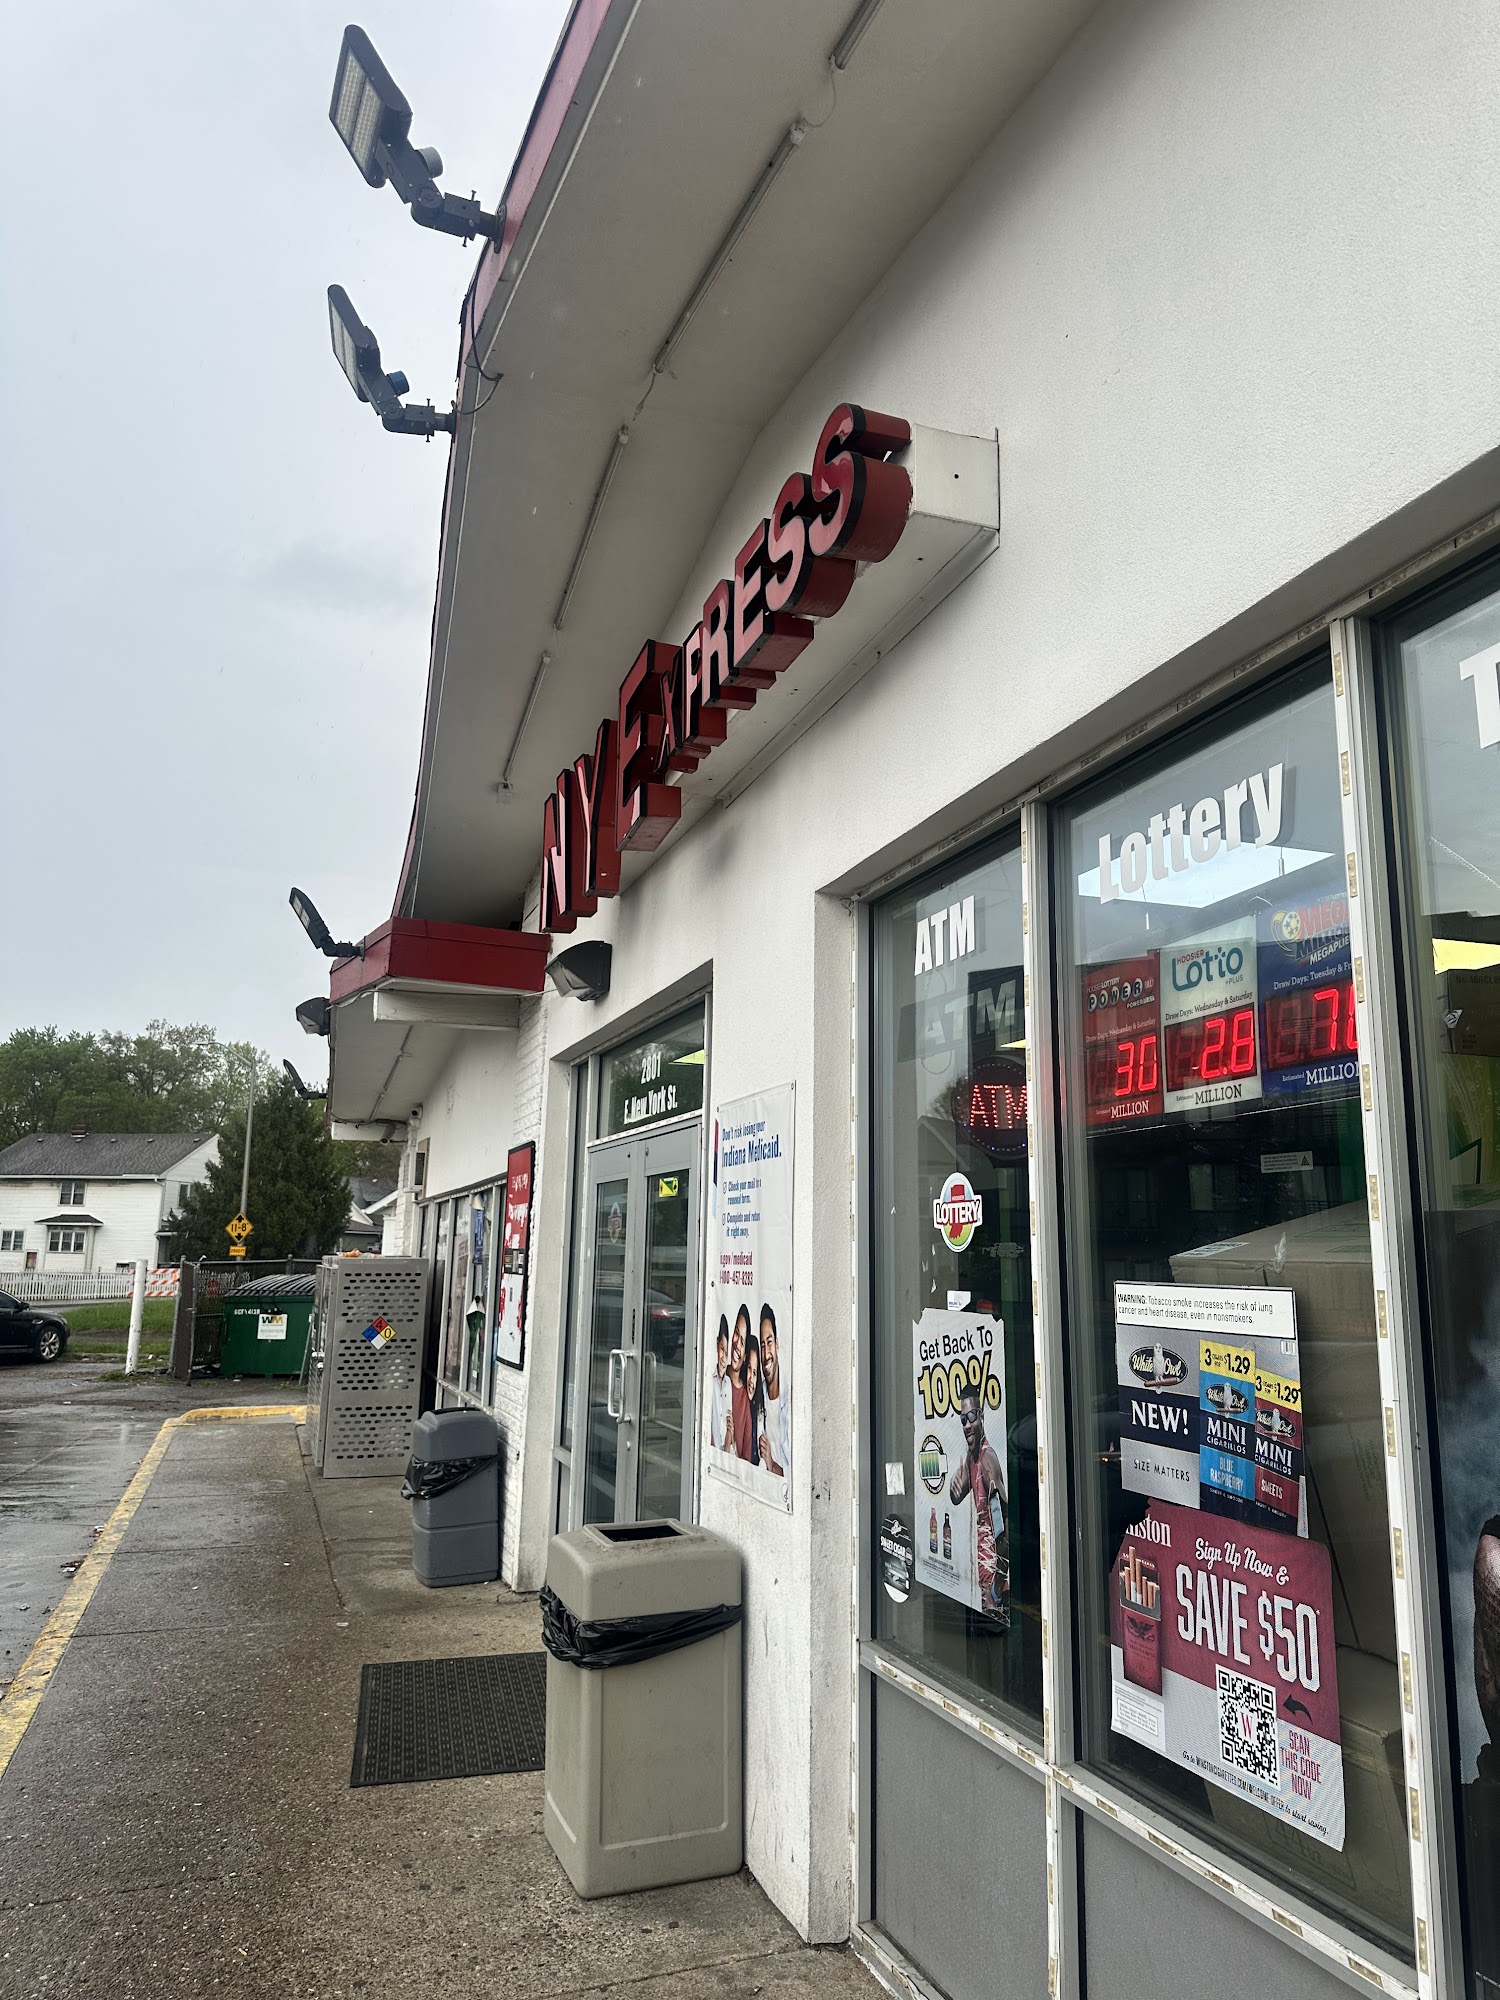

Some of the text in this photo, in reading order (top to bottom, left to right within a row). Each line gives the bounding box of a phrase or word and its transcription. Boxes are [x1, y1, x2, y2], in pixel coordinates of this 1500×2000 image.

[540, 402, 895, 933] NY EXPRESS
[1100, 763, 1284, 904] Lottery
[1298, 898, 1350, 939] MEG
[914, 895, 975, 976] ATM
[1310, 932, 1350, 965] MEGAPLIE
[1176, 949, 1205, 965] HOOSIER
[1274, 979, 1291, 990] Draw
[1291, 973, 1309, 987] Days:
[1310, 965, 1337, 981] Tuesday
[1337, 964, 1343, 972] &
[1165, 1009, 1179, 1021] Draw
[1194, 998, 1224, 1014] Wednesday
[1224, 998, 1229, 1006] &
[1229, 991, 1253, 1005] Saturday
[1137, 1017, 1156, 1029] Saturday
[1201, 1010, 1254, 1079] 2.8
[641, 1051, 662, 1084] 2801
[1115, 1035, 1157, 1097] 30
[624, 1084, 678, 1125] E. New York St.
[969, 1083, 1028, 1130] ATM
[1195, 1084, 1242, 1105] MILLION
[1111, 1100, 1149, 1119] MILLION
[722, 1120, 766, 1142] Don't risk losing your
[722, 1134, 782, 1168] Indiana Medicaid.
[728, 1180, 740, 1192] Check
[739, 1180, 747, 1193] your
[747, 1177, 756, 1190] mail
[726, 1211, 744, 1225] Complete
[743, 1211, 751, 1222] and
[936, 1200, 981, 1225] LOTTERY
[726, 1226, 730, 1237] it
[730, 1226, 740, 1239] right
[1117, 1293, 1274, 1315] WARNING: Tobacco smoke increases the risk of lung
[1118, 1306, 1255, 1325] cancer and heart disease, even in nonsmokers.
[261, 1316, 284, 1324] WM
[367, 1328, 392, 1339] 2 0
[375, 1319, 384, 1330] 4
[919, 1324, 994, 1362] Get Back To
[1131, 1353, 1182, 1377] White Owl
[1204, 1348, 1213, 1367] 3
[1223, 1353, 1251, 1375] $1.29
[918, 1350, 1002, 1420] 100%
[1207, 1387, 1224, 1403] White
[1255, 1375, 1263, 1392] 3
[1274, 1382, 1300, 1404] $1.29
[1131, 1399, 1189, 1436] NEW!
[1206, 1416, 1247, 1446] MINI
[1206, 1435, 1247, 1455] CIGARILLOS
[1255, 1437, 1293, 1468] MINI
[1133, 1458, 1191, 1483] SIZE MATTERS
[1219, 1456, 1234, 1474] BLUE
[1254, 1454, 1293, 1476] CIGARILLOS
[1209, 1468, 1244, 1492] RASPBERRY
[1260, 1479, 1284, 1500] SWEETS
[1195, 1537, 1290, 1586] Sign Up Now &
[1176, 1563, 1251, 1666] SAVE
[1240, 1711, 1254, 1740] W
[1288, 1729, 1312, 1758] SCAN
[1280, 1747, 1323, 1784] THIS CODE
[1182, 1750, 1190, 1761] Go
[1291, 1809, 1307, 1823] start
[1307, 1818, 1329, 1837] saving.
[1291, 1773, 1312, 1801] NOW
